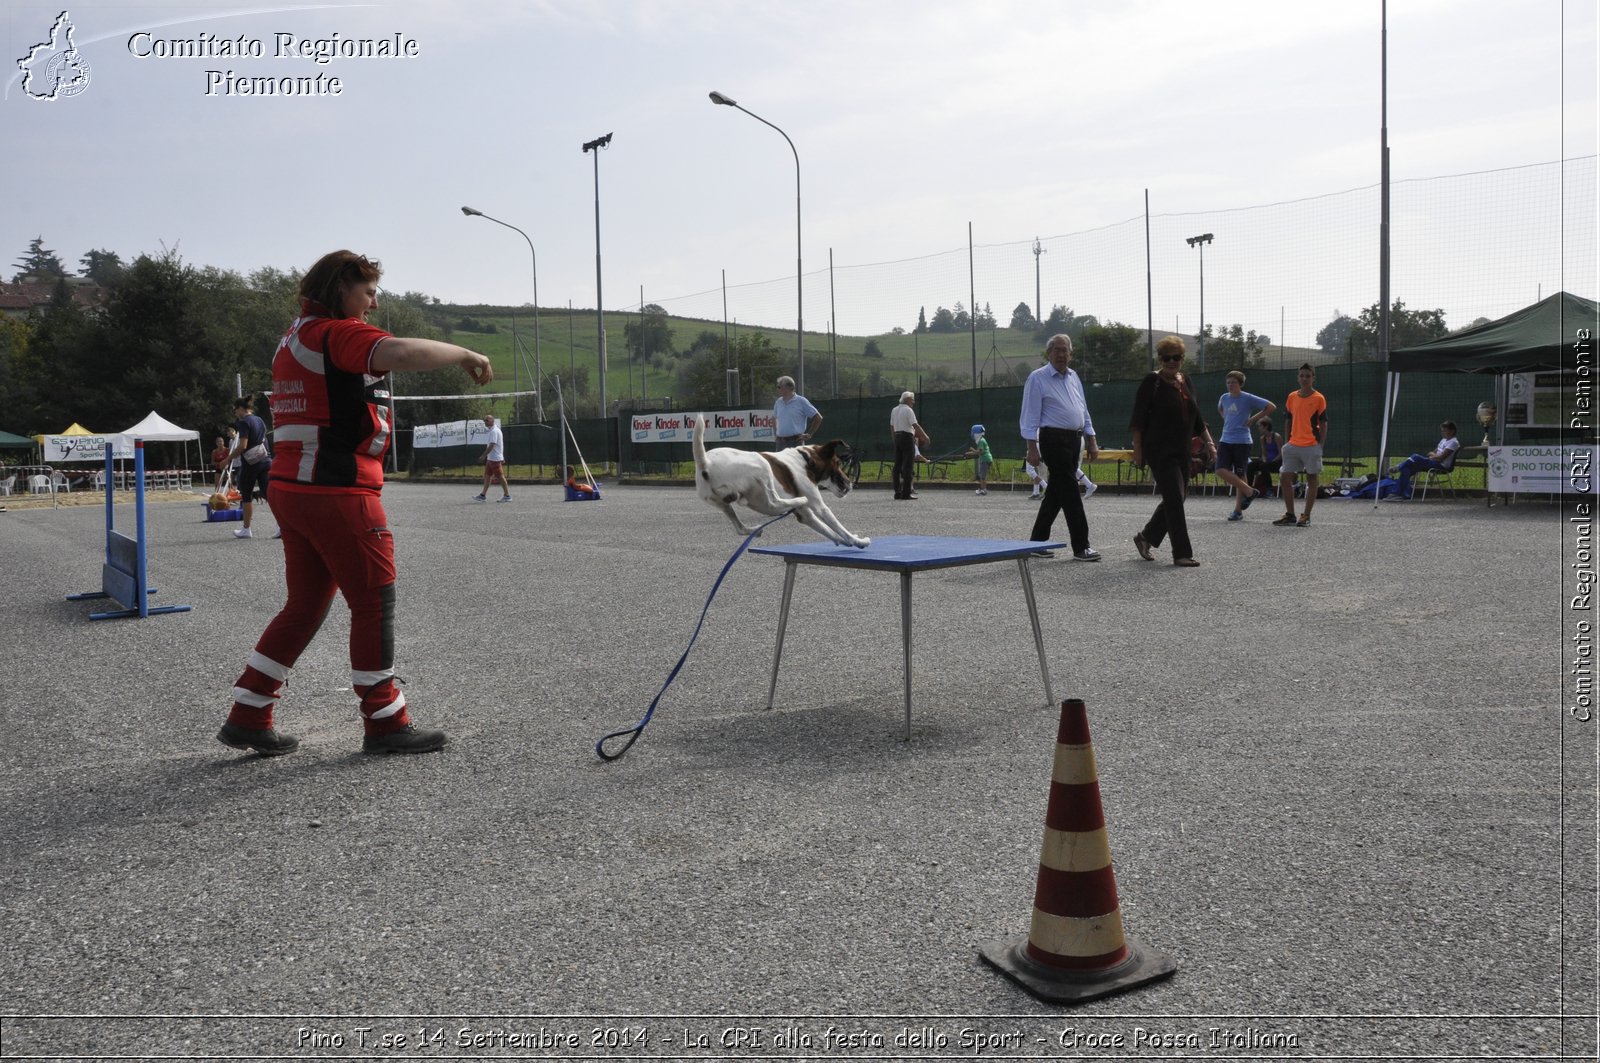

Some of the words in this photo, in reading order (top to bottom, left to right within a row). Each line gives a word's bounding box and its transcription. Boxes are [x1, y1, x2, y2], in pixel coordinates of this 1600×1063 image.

[749, 412, 776, 427] kinde
[78, 437, 105, 445] PINO
[1511, 448, 1553, 457] SCUOLA
[1511, 462, 1536, 471] PINO
